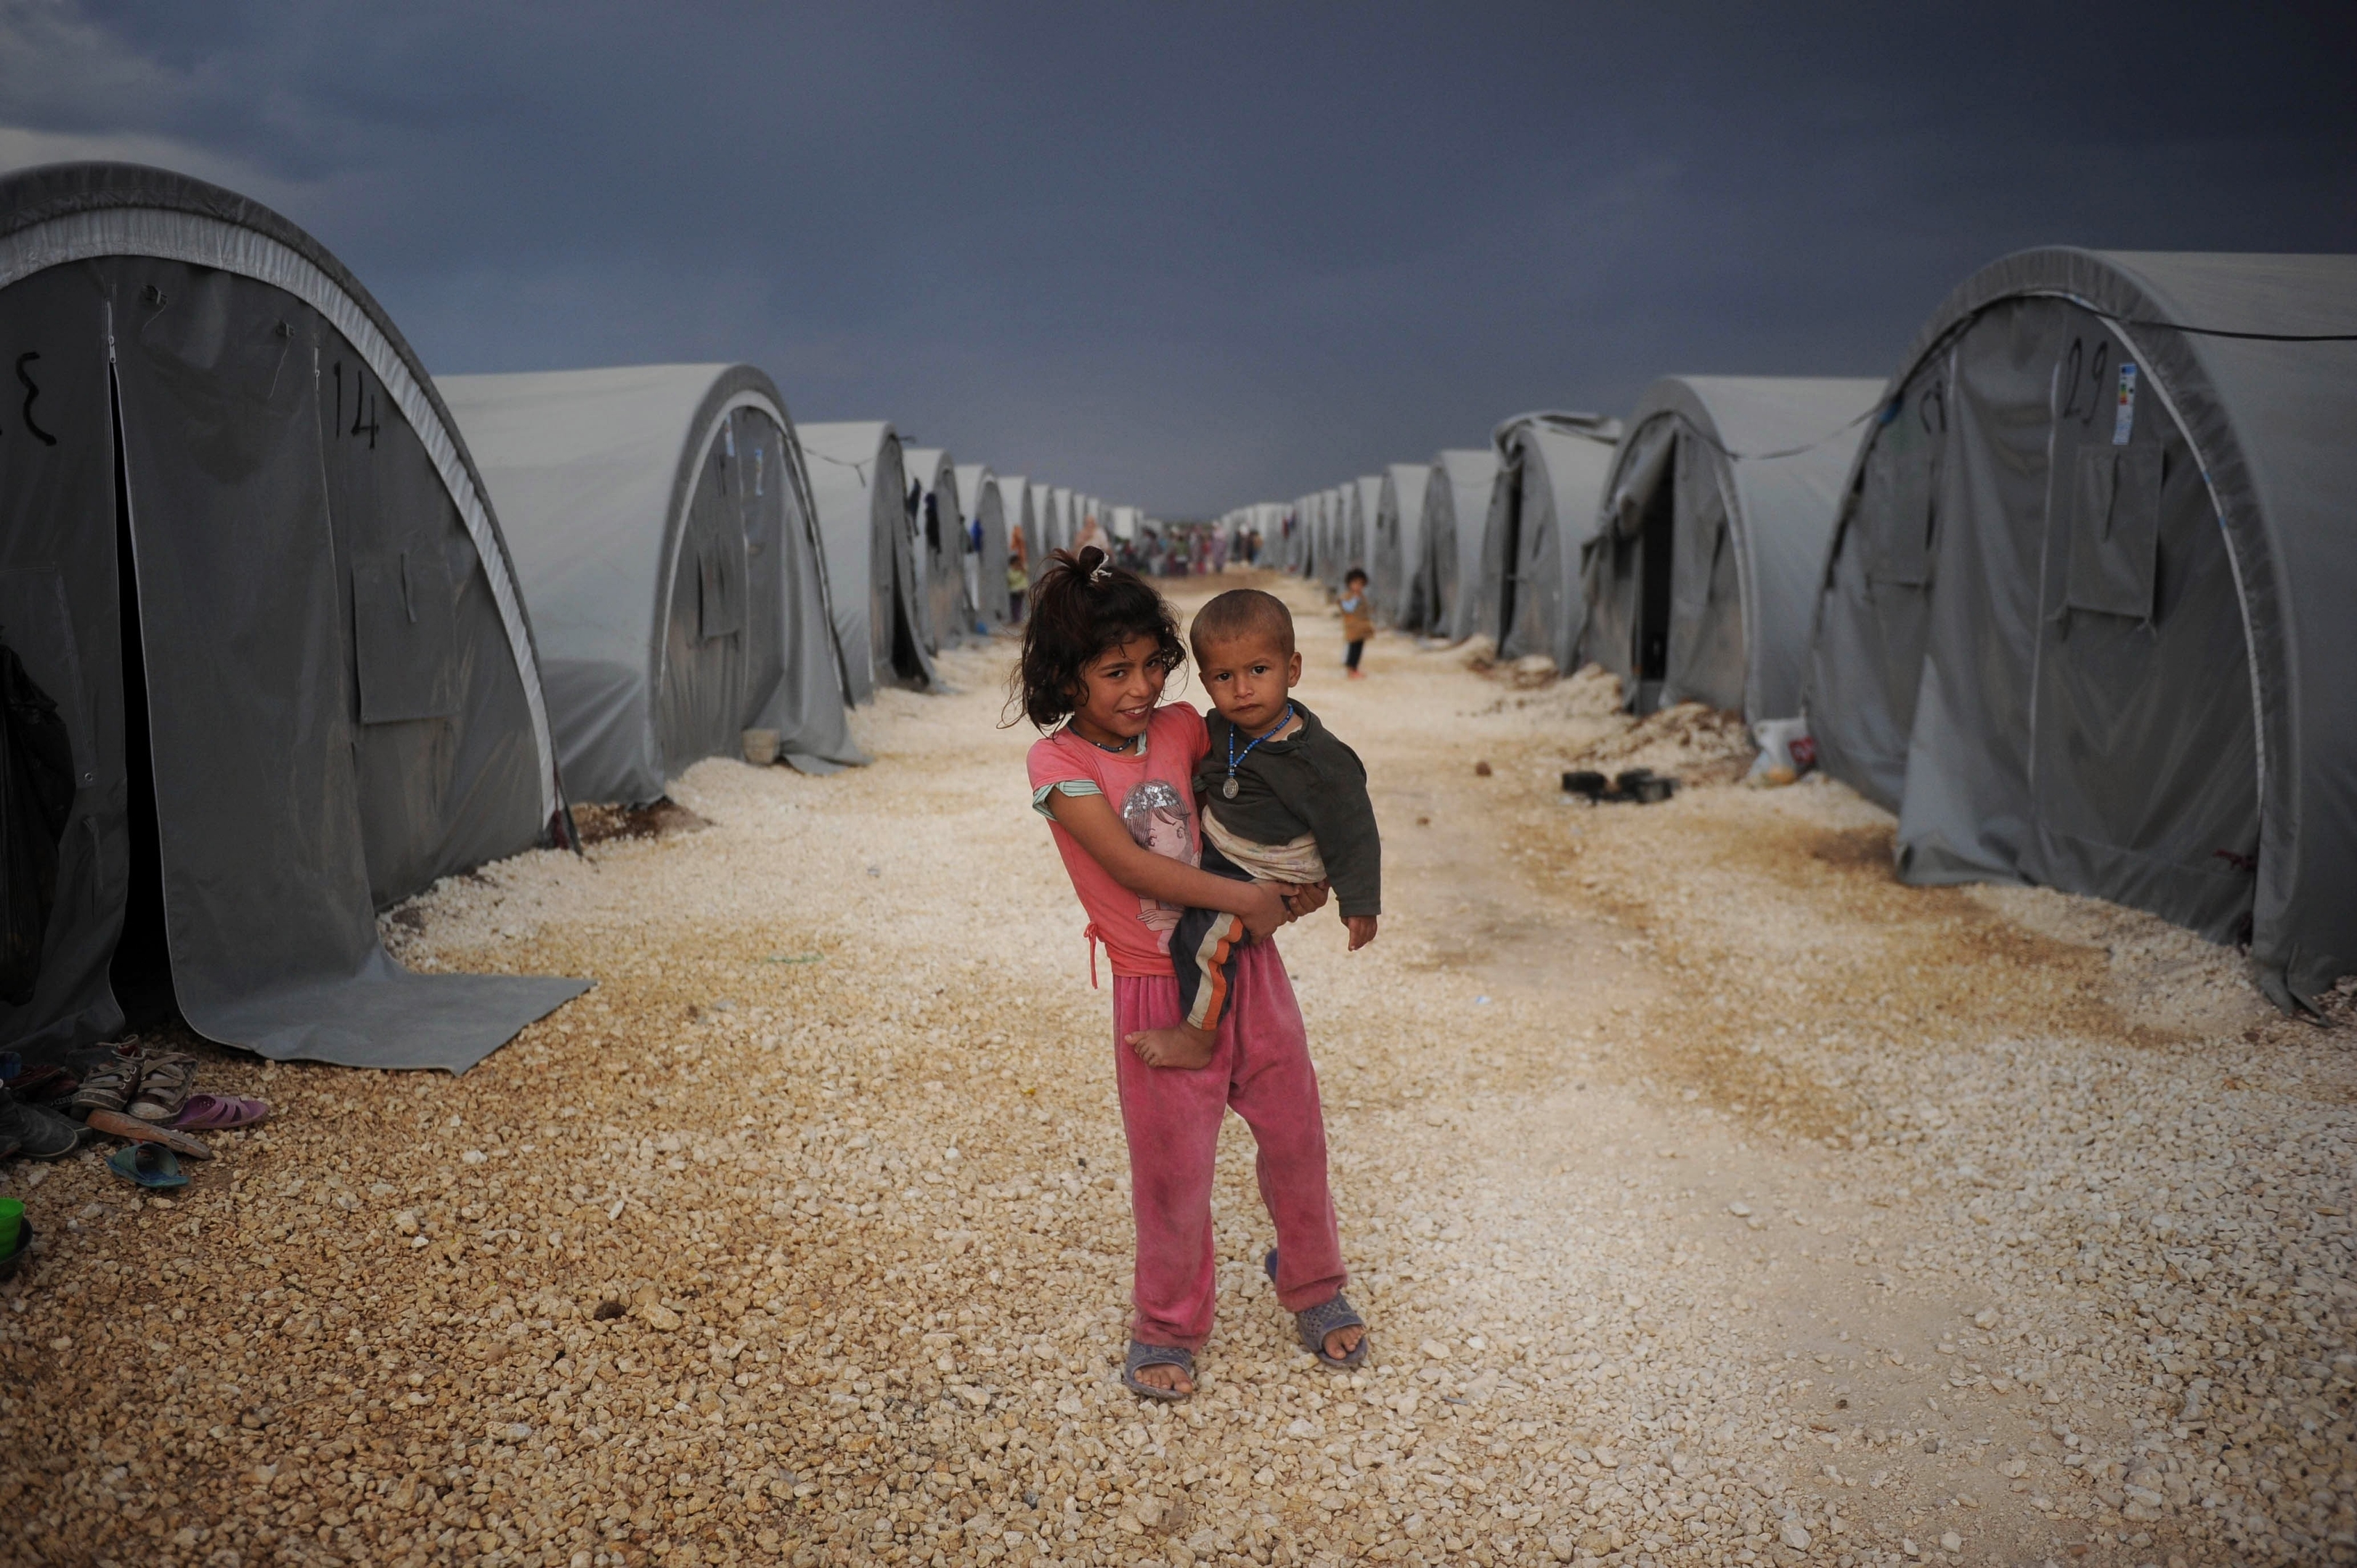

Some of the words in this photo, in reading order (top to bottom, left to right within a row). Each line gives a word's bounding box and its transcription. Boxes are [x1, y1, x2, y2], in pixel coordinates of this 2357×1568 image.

[0, 351, 57, 446] ٤
[333, 361, 380, 450] 14
[2063, 336, 2109, 426] 29
